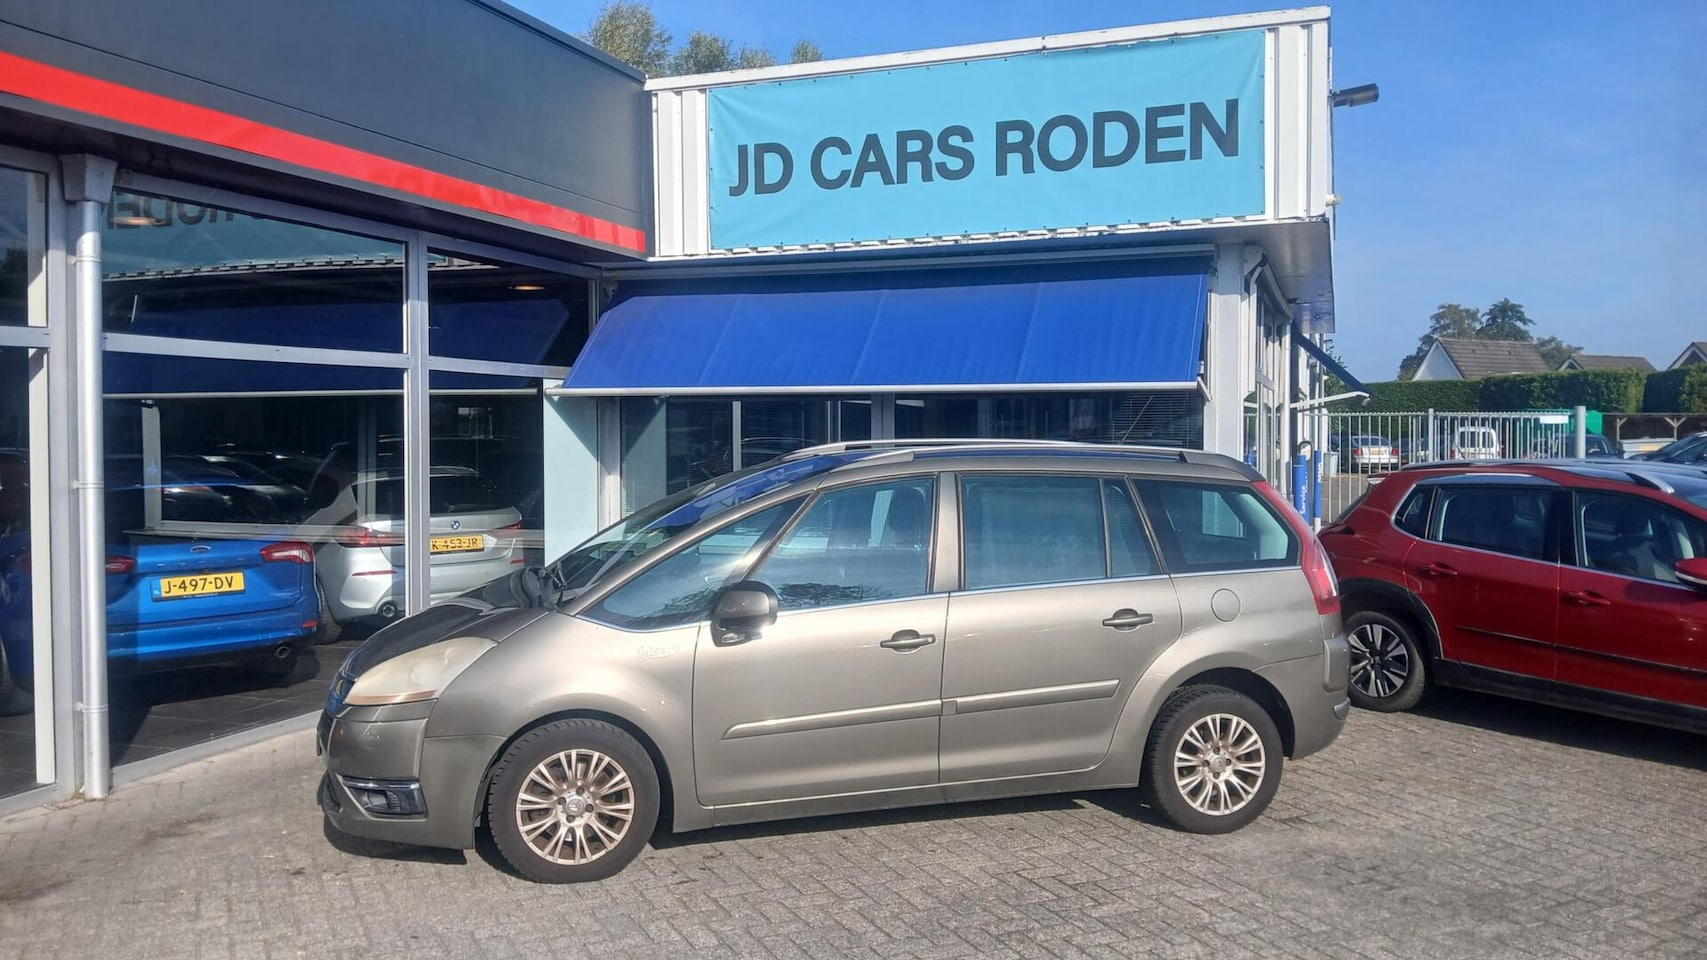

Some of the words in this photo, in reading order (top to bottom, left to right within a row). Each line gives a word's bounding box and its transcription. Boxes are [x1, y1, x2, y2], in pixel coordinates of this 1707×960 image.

[728, 142, 794, 197] JD
[810, 125, 975, 190] CARS
[995, 98, 1239, 177] RODEN
[431, 536, 479, 551] K453-JR
[164, 575, 234, 594] J-497-DV
